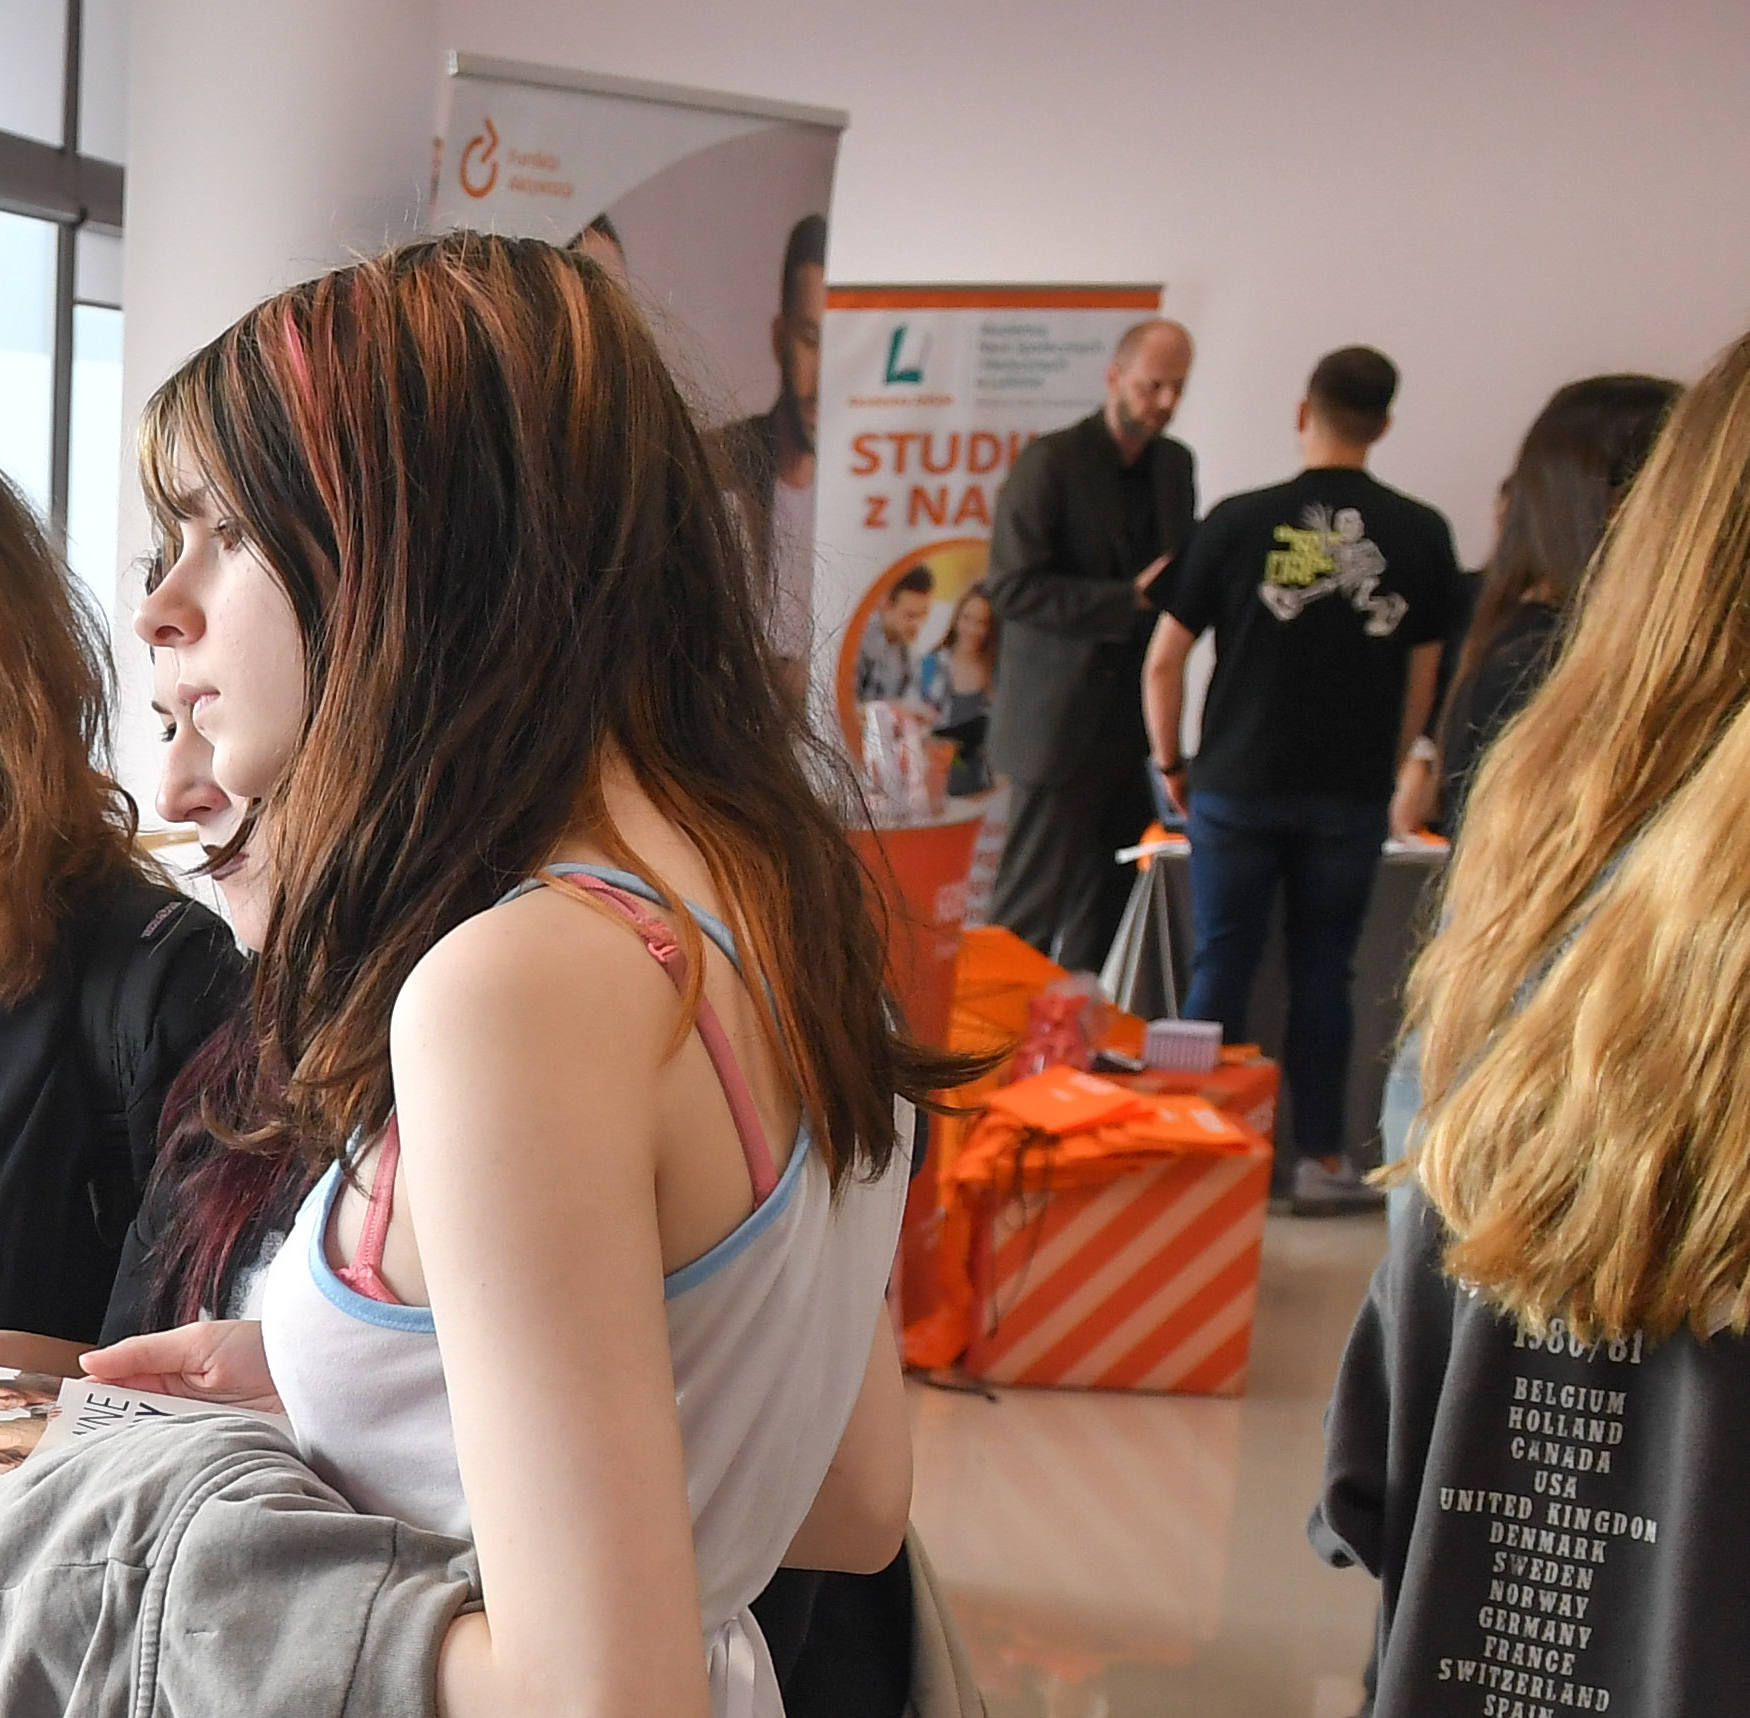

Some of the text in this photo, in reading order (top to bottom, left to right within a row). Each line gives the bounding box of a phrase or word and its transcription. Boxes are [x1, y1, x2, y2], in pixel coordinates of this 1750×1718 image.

[852, 432, 1038, 476] STUDI
[907, 484, 1002, 527] NA
[1513, 1375, 1627, 1415] BELGIUM
[1507, 1405, 1624, 1446] HOLLAND
[1509, 1437, 1611, 1473] CANADA
[1533, 1469, 1578, 1499] USA
[1439, 1487, 1659, 1544] UNITED KINGDOM
[1489, 1521, 1606, 1563] DENMARK
[1492, 1551, 1594, 1590] SWEDEN
[1489, 1579, 1589, 1620] NORWAY
[1478, 1607, 1593, 1650] GERMANY
[1483, 1635, 1575, 1676] FRANCE
[1438, 1657, 1609, 1712] SWITZERLAND
